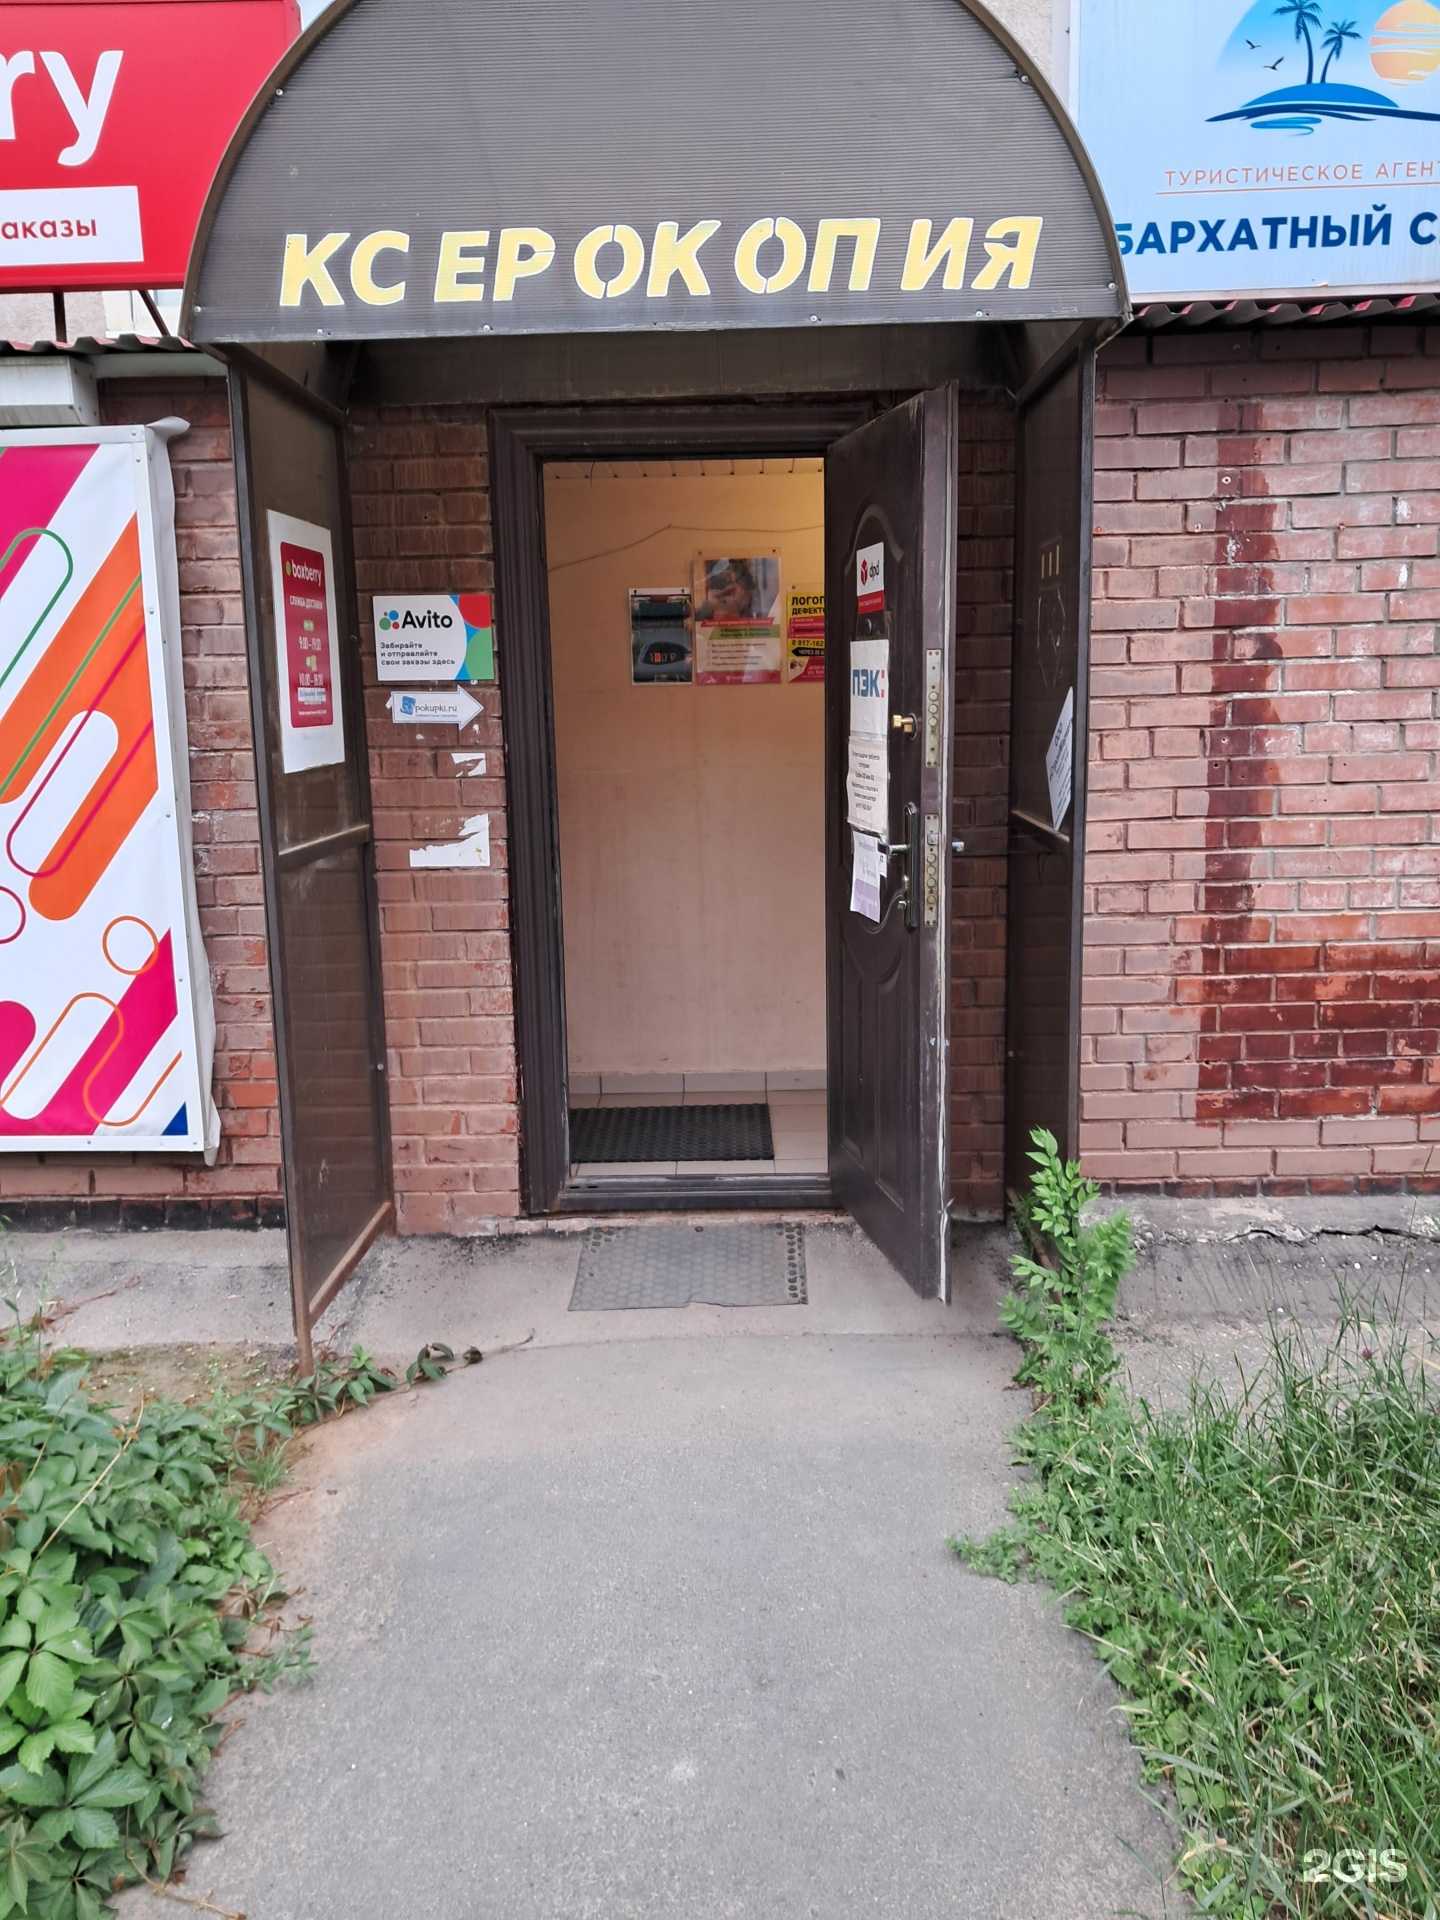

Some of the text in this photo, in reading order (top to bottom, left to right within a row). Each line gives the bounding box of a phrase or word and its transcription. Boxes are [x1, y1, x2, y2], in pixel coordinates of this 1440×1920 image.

[1164, 160, 1440, 187] ТУРИСТИЧЕСКОЕ АГЕН
[1, 217, 97, 241] аказы
[1114, 203, 1440, 256] БАРХАТНЫЙ С
[292, 560, 322, 587] boxberry
[869, 559, 880, 581] dpd
[401, 609, 453, 629] Avito
[380, 641, 423, 649] Забирайте
[387, 650, 438, 658] отправляйте
